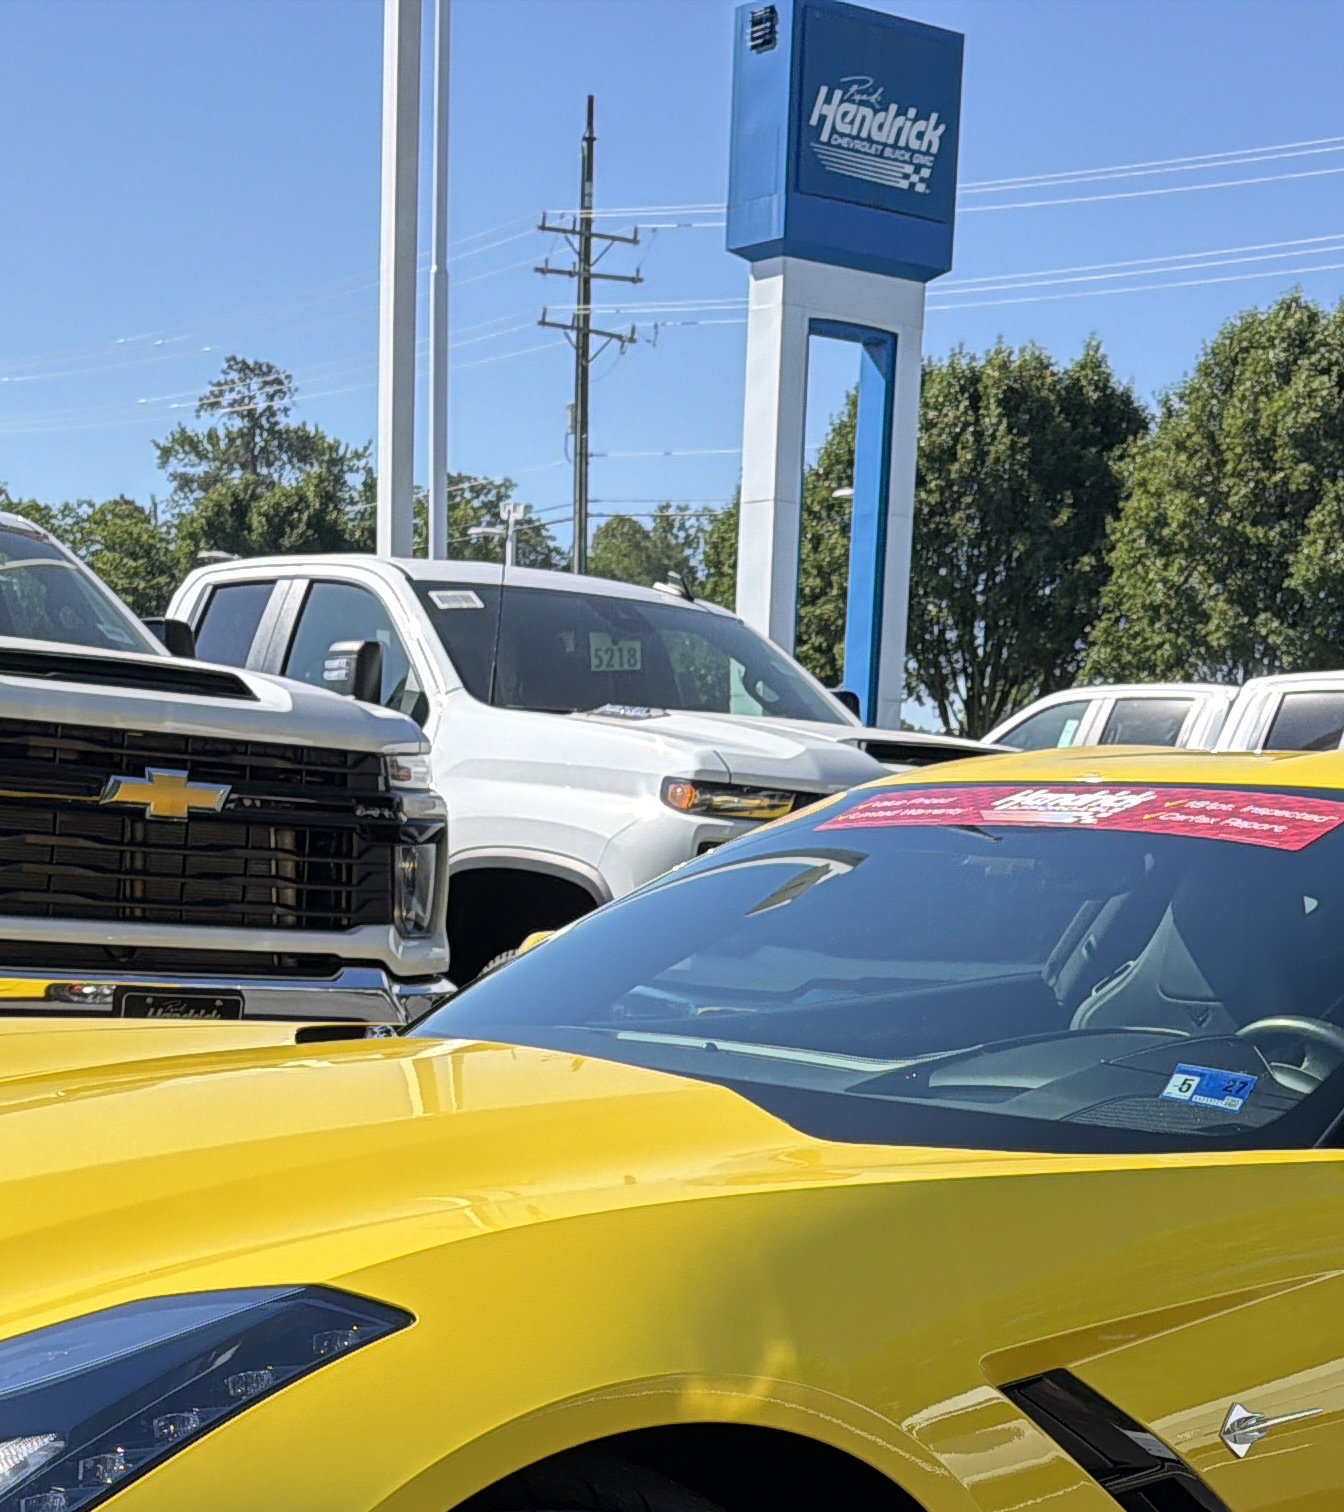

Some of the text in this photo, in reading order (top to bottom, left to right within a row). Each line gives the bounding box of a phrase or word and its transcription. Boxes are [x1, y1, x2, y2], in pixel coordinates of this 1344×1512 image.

[809, 85, 946, 154] Hendrick
[830, 134, 935, 167] CHEVROLET BUICK GMC
[594, 647, 638, 668] 5218
[990, 789, 1158, 818] Hendrick
[1222, 1079, 1249, 1095] 27
